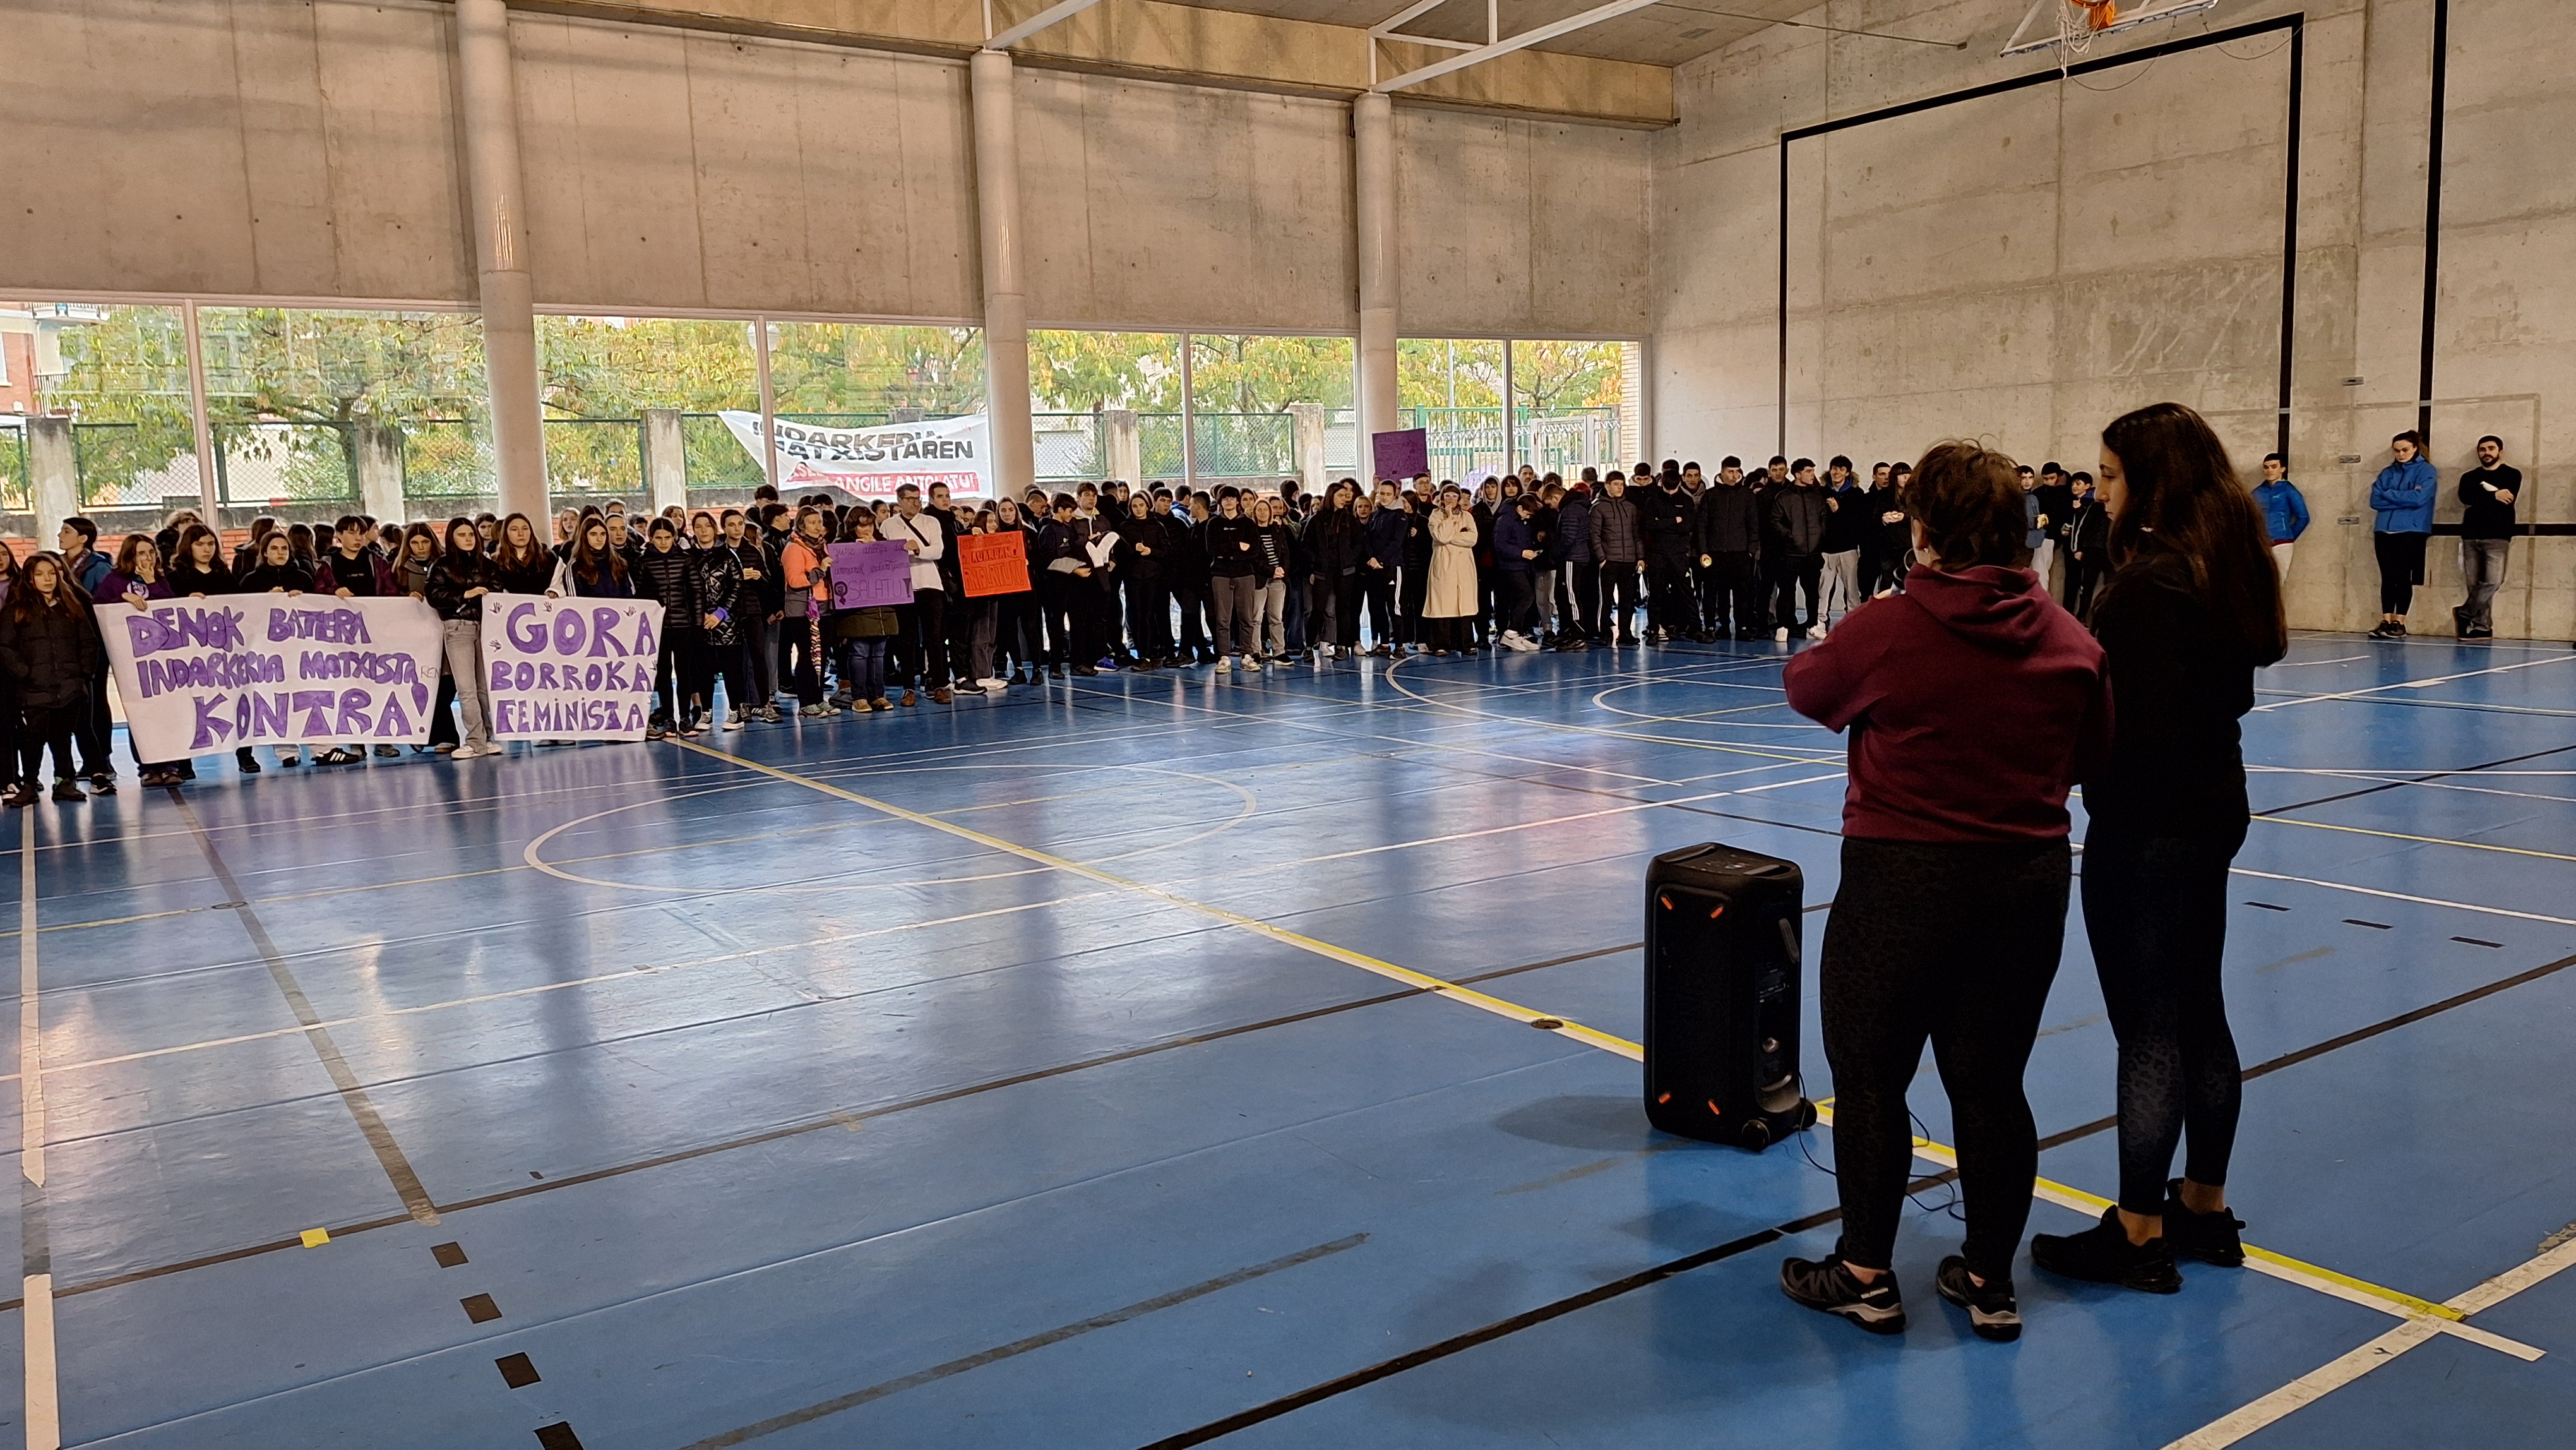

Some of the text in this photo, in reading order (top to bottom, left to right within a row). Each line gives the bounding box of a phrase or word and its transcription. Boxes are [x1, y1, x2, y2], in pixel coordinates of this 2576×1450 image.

[775, 440, 973, 460] ATXISTAREN
[126, 606, 372, 657] DENOK BATERA
[506, 602, 657, 657] GORA
[136, 651, 285, 698] INDARKERIA
[300, 651, 418, 685] MATXISTA
[490, 661, 653, 693] BORROKA
[189, 683, 429, 750] KONTRA!
